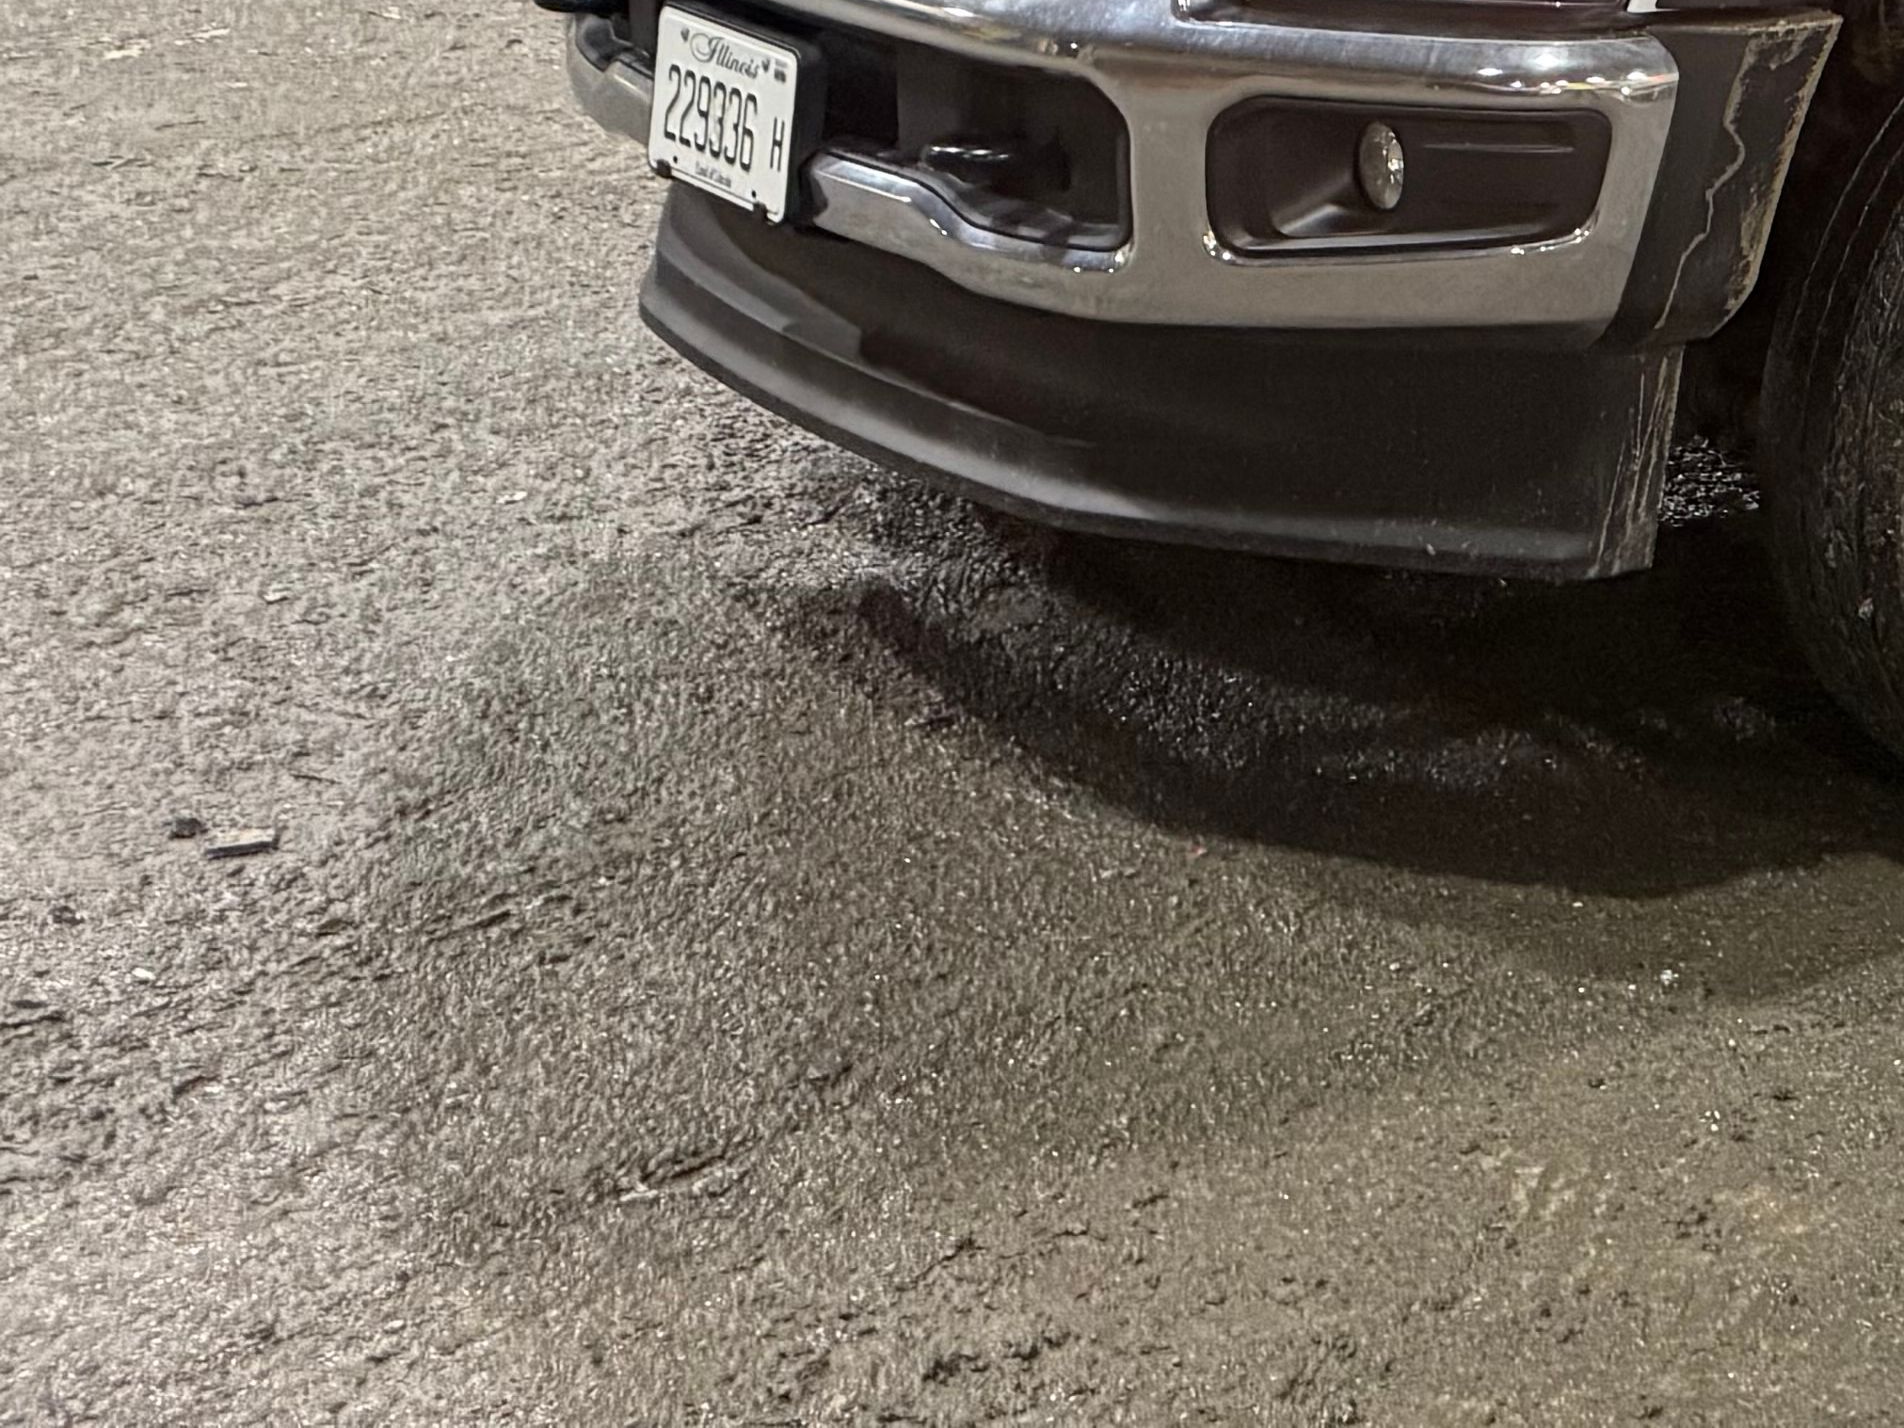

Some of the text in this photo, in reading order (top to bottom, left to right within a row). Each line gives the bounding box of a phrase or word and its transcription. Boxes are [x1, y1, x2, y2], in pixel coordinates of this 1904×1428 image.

[690, 32, 761, 80] Illinois
[664, 64, 785, 172] 229336 H
